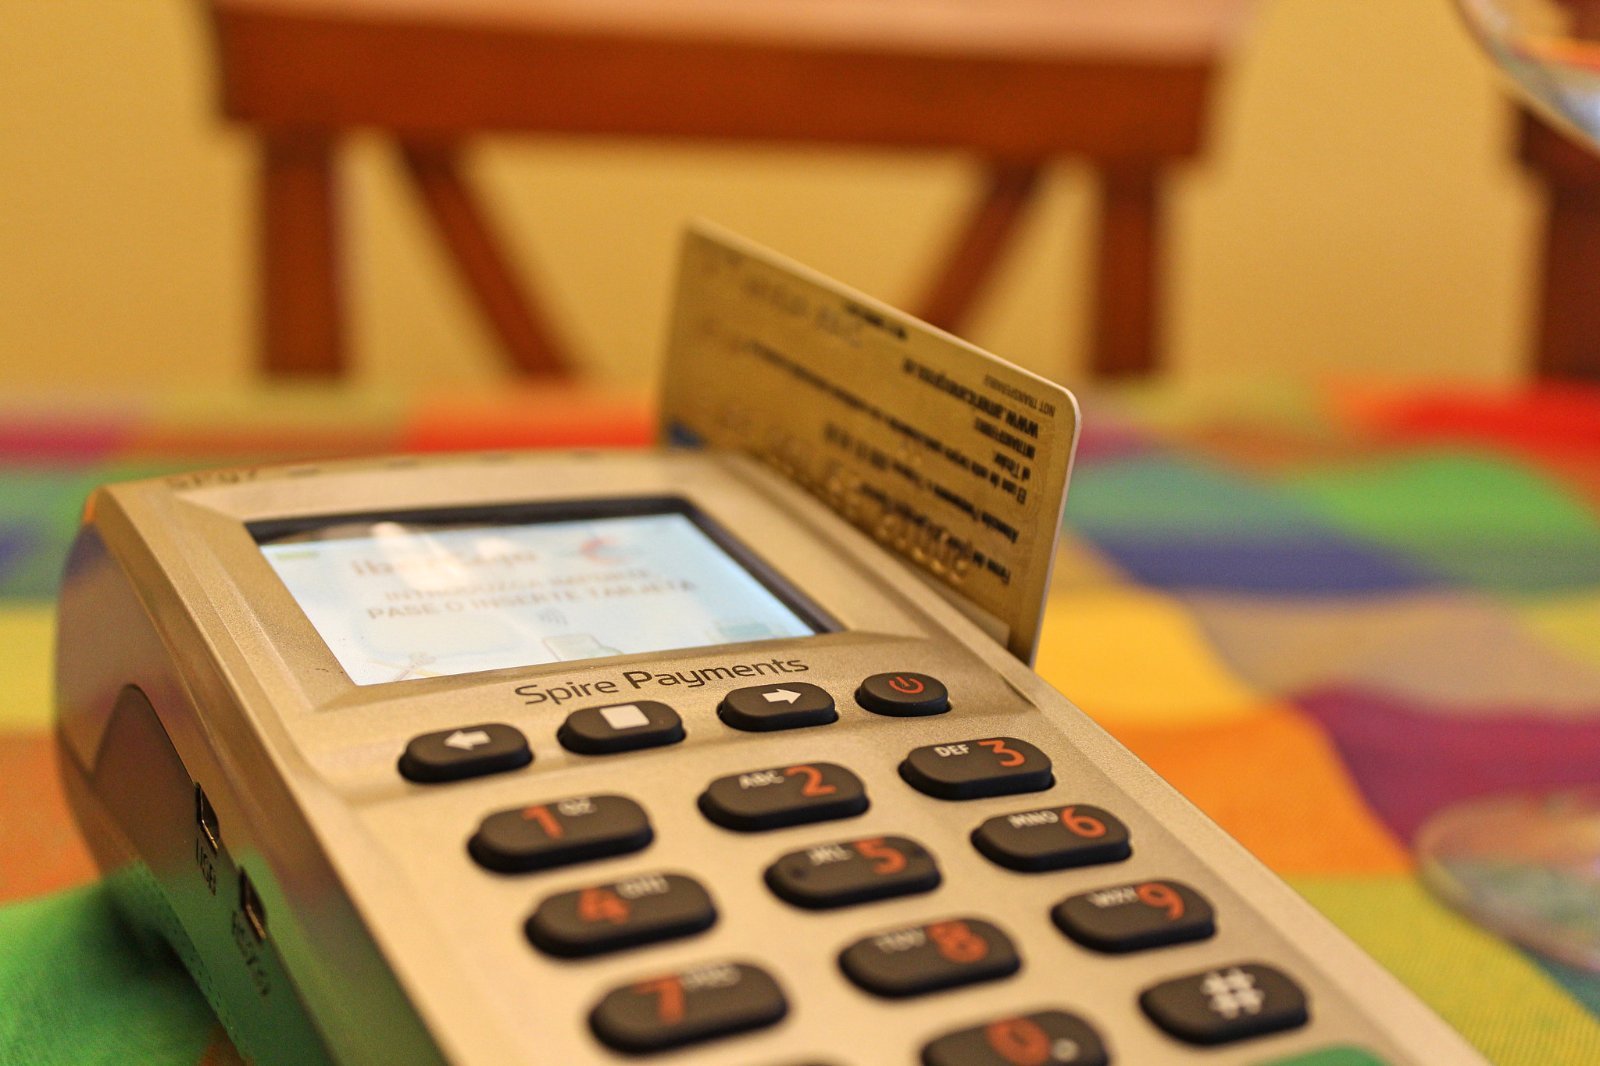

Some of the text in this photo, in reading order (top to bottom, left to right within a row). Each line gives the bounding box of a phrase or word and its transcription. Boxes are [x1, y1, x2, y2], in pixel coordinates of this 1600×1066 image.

[1038, 400, 1056, 418] NOT
[514, 658, 810, 705] Spire Payments
[934, 739, 1026, 768] DEF 3
[784, 764, 838, 797] 2
[521, 804, 566, 840] 1
[1060, 805, 1107, 839] 6
[854, 837, 907, 876] 5
[578, 886, 631, 925] 4
[1135, 881, 1186, 922] 9
[924, 918, 989, 965] 8
[632, 975, 686, 1026] 7
[985, 1016, 1052, 1066] 0
